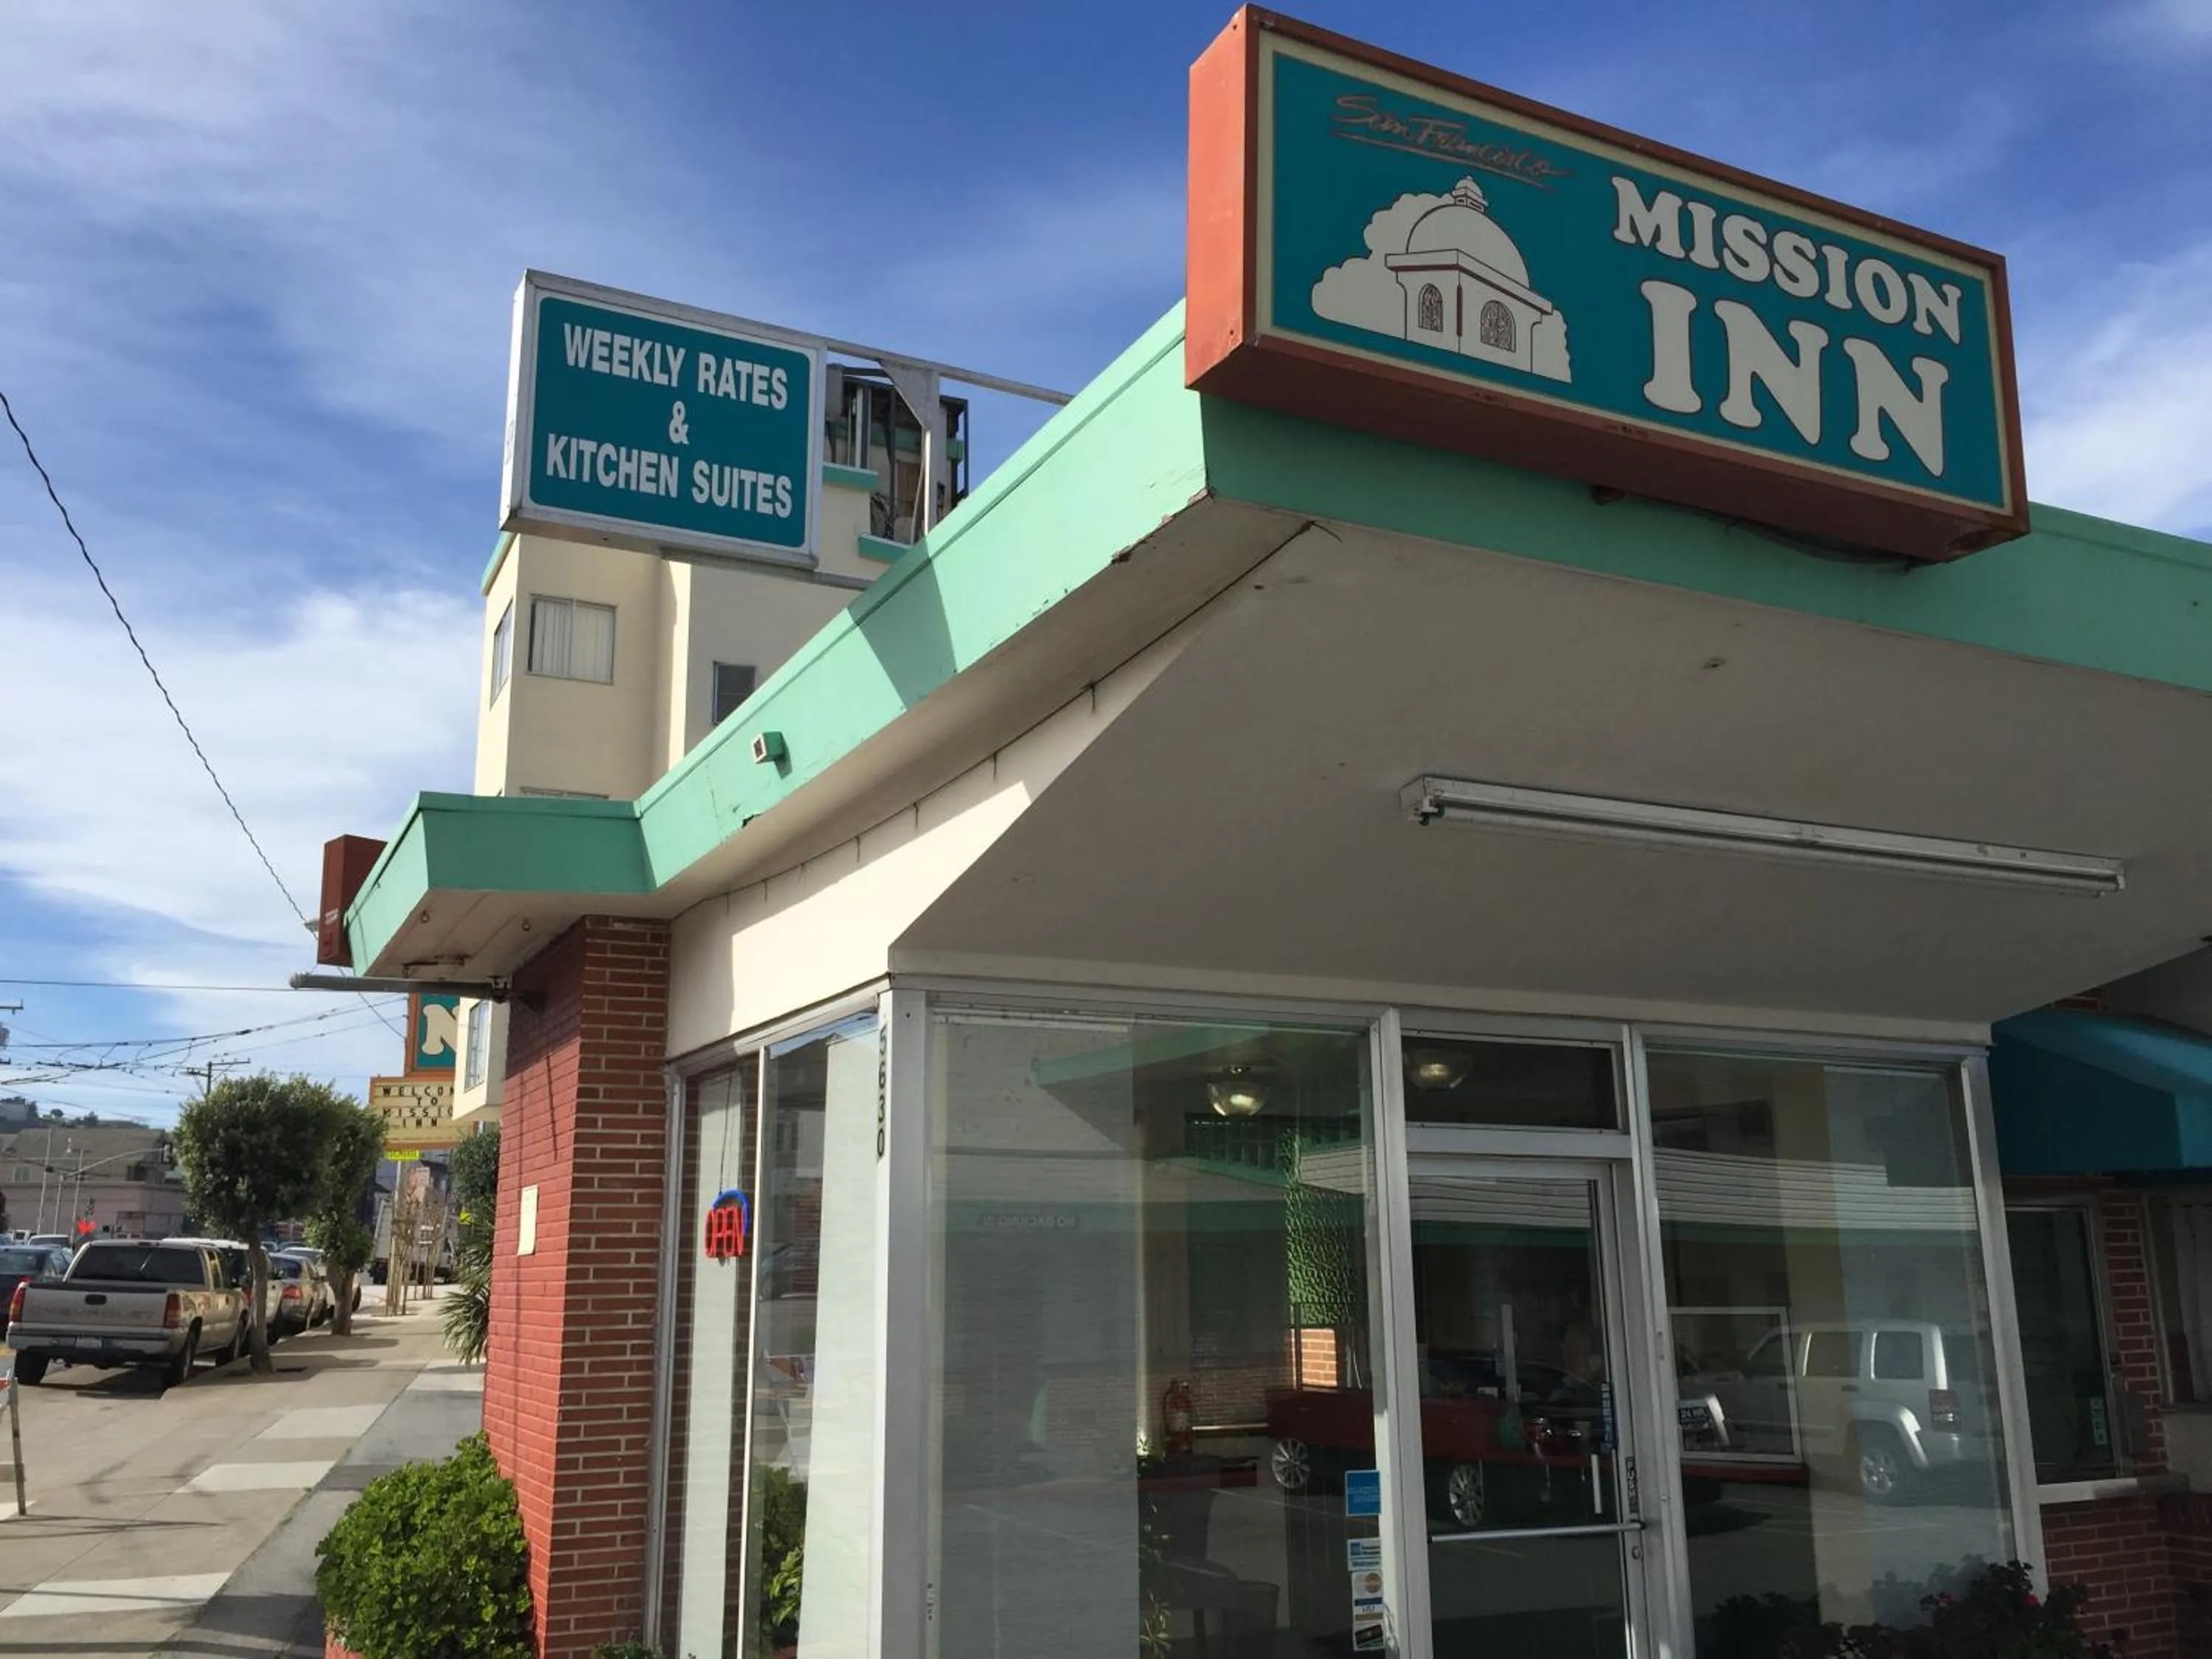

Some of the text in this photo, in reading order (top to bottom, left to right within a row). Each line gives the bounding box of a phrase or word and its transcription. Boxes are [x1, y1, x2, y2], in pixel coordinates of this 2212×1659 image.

[1332, 95, 1573, 177] San Francisco
[1611, 175, 1962, 346] MISSION
[563, 322, 789, 411] WEEKLY RATES
[1641, 279, 1949, 478] INN
[669, 400, 689, 445] &
[546, 433, 793, 519] KITCHEN SUITES
[382, 1085, 455, 1097] WELCO
[402, 1118, 438, 1129] INN
[416, 1096, 439, 1107] TO
[877, 1023, 888, 1157] 5630
[705, 1206, 744, 1258] OPEN
[1627, 1461, 1638, 1499] PUSH
